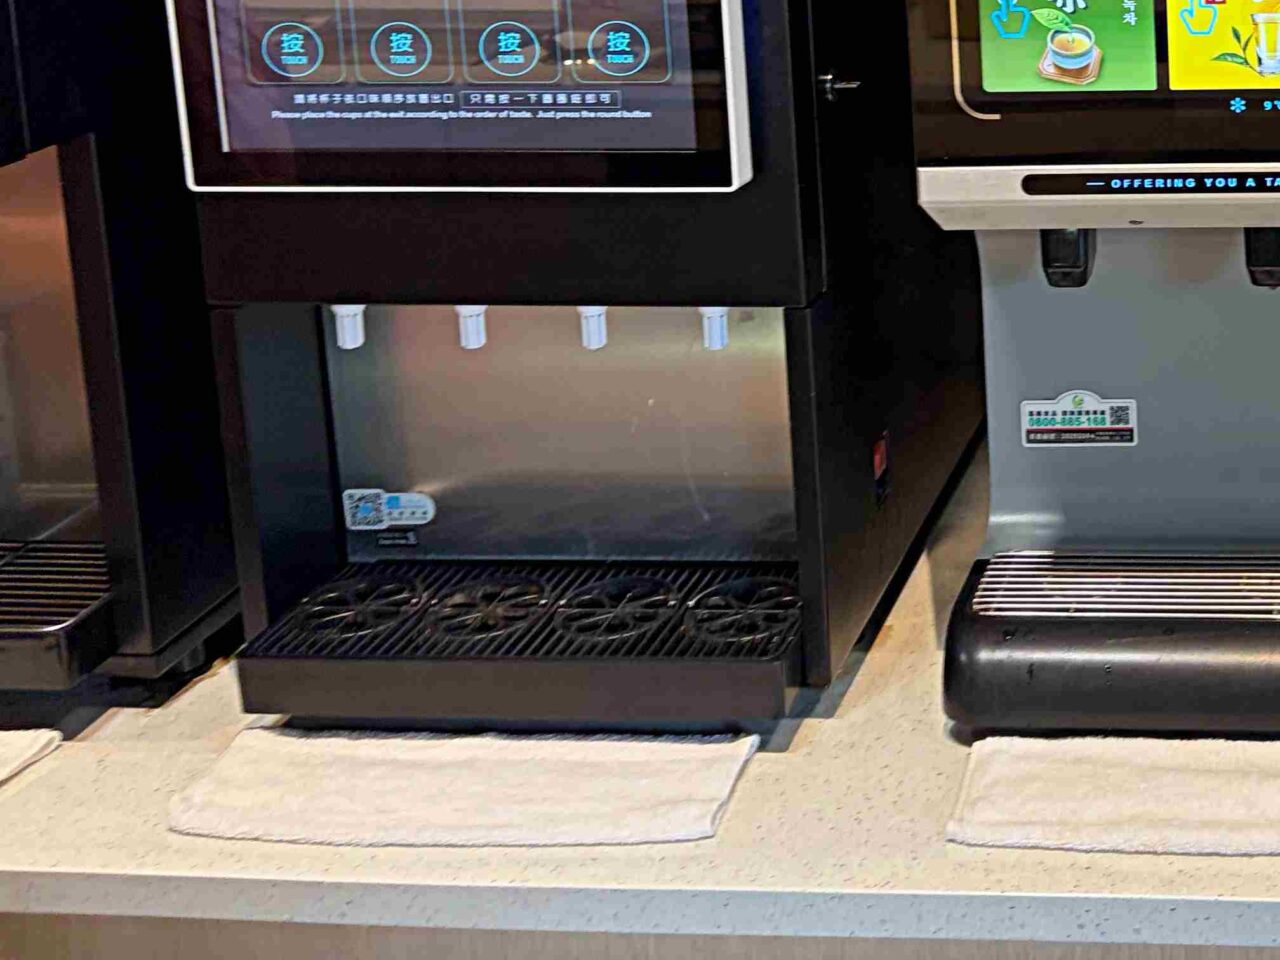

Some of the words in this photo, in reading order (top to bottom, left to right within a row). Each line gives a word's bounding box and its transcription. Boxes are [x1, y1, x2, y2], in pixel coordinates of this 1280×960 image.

[281, 32, 305, 52] 按
[389, 32, 413, 52] 按
[498, 31, 522, 52] 按
[607, 31, 631, 52] 按
[1110, 177, 1197, 189] OFFERING
[1204, 177, 1238, 187] YOU
[1246, 177, 1256, 187] A
